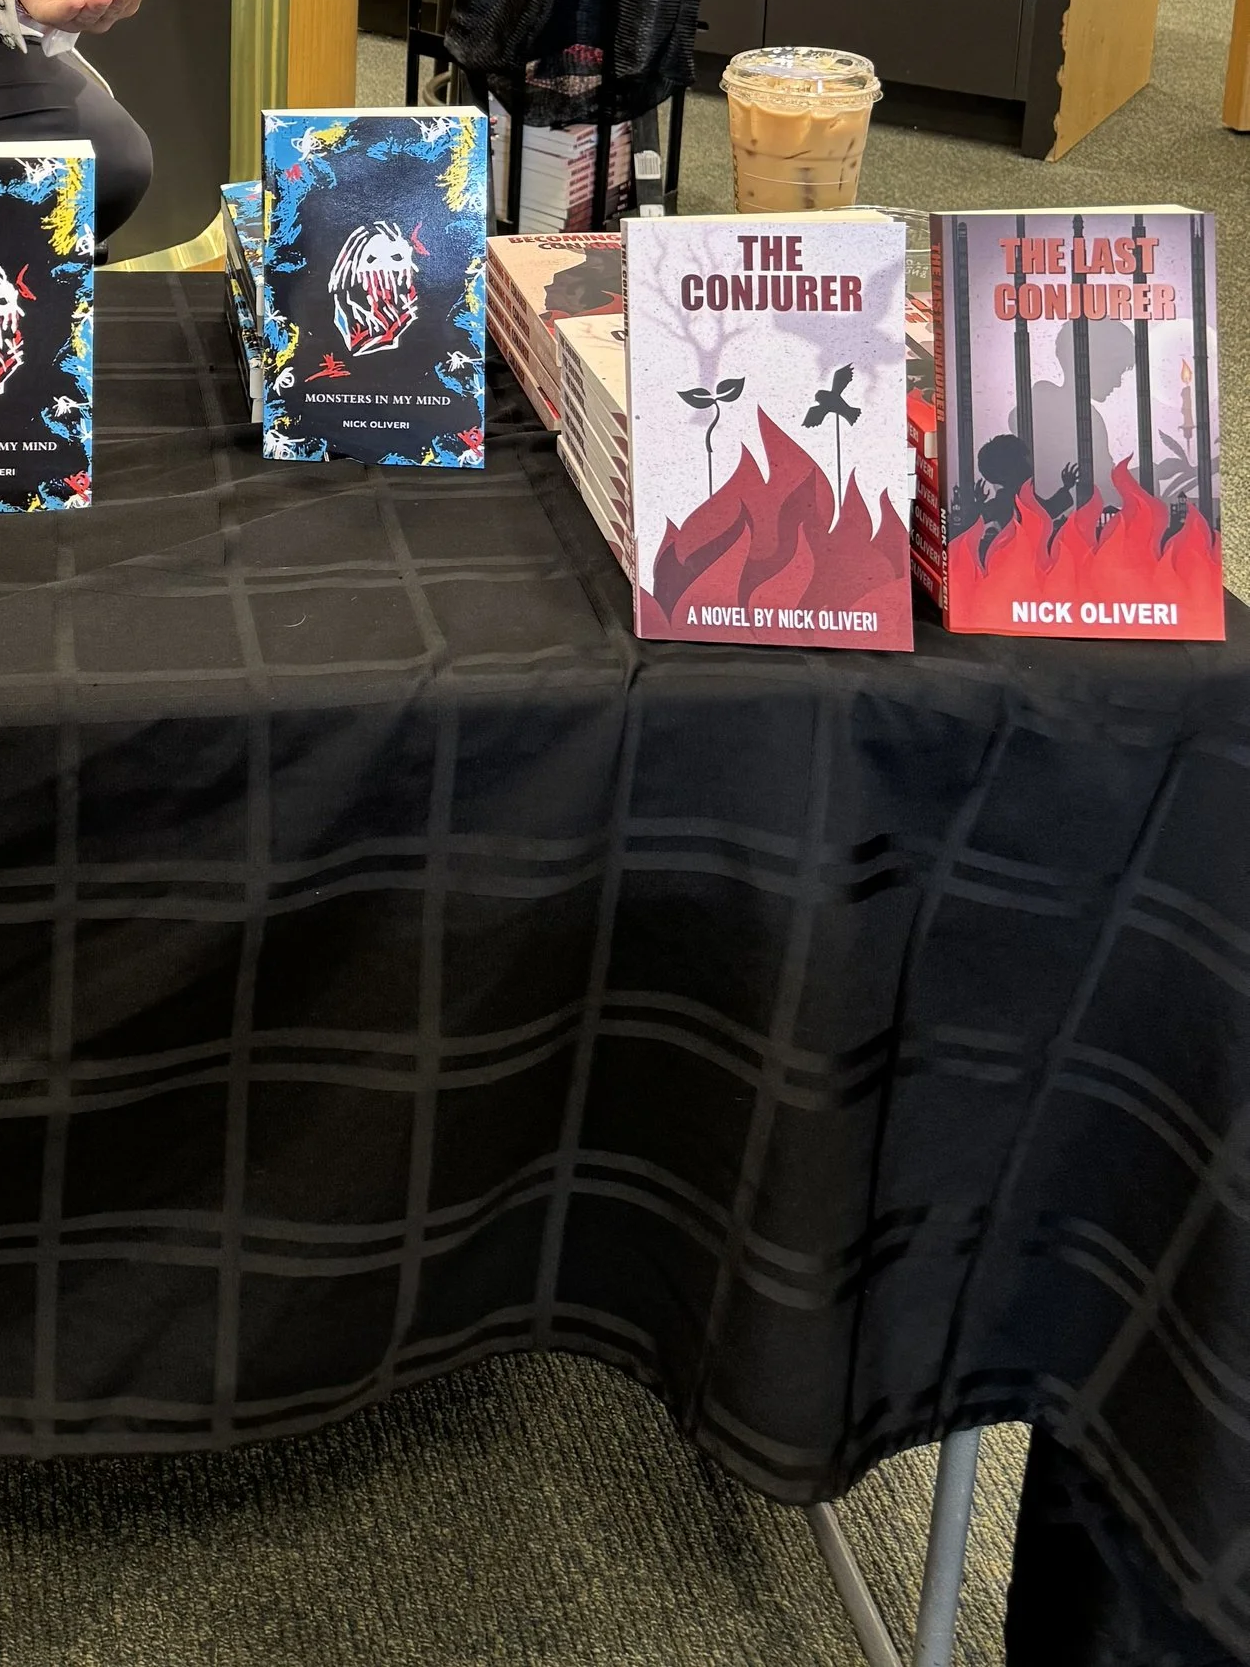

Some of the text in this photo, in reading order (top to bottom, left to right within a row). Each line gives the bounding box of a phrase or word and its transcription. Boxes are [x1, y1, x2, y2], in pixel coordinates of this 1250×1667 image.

[508, 234, 621, 244] BECOMING
[737, 235, 803, 271] THE
[1000, 237, 1160, 275] THE LAST
[680, 273, 863, 312] CONJURER
[993, 283, 1177, 321] CONJURER
[931, 242, 945, 423] THE LAST CONJURER
[305, 393, 451, 406] MONSTERS IN MY MIND
[342, 420, 410, 430] NICK OLIVERI
[22, 441, 58, 452] MIND
[940, 507, 948, 547] NICK
[687, 605, 878, 632] A NOVEL BY NICK OLIVERI
[1011, 600, 1178, 625] NICK OLIVERI
